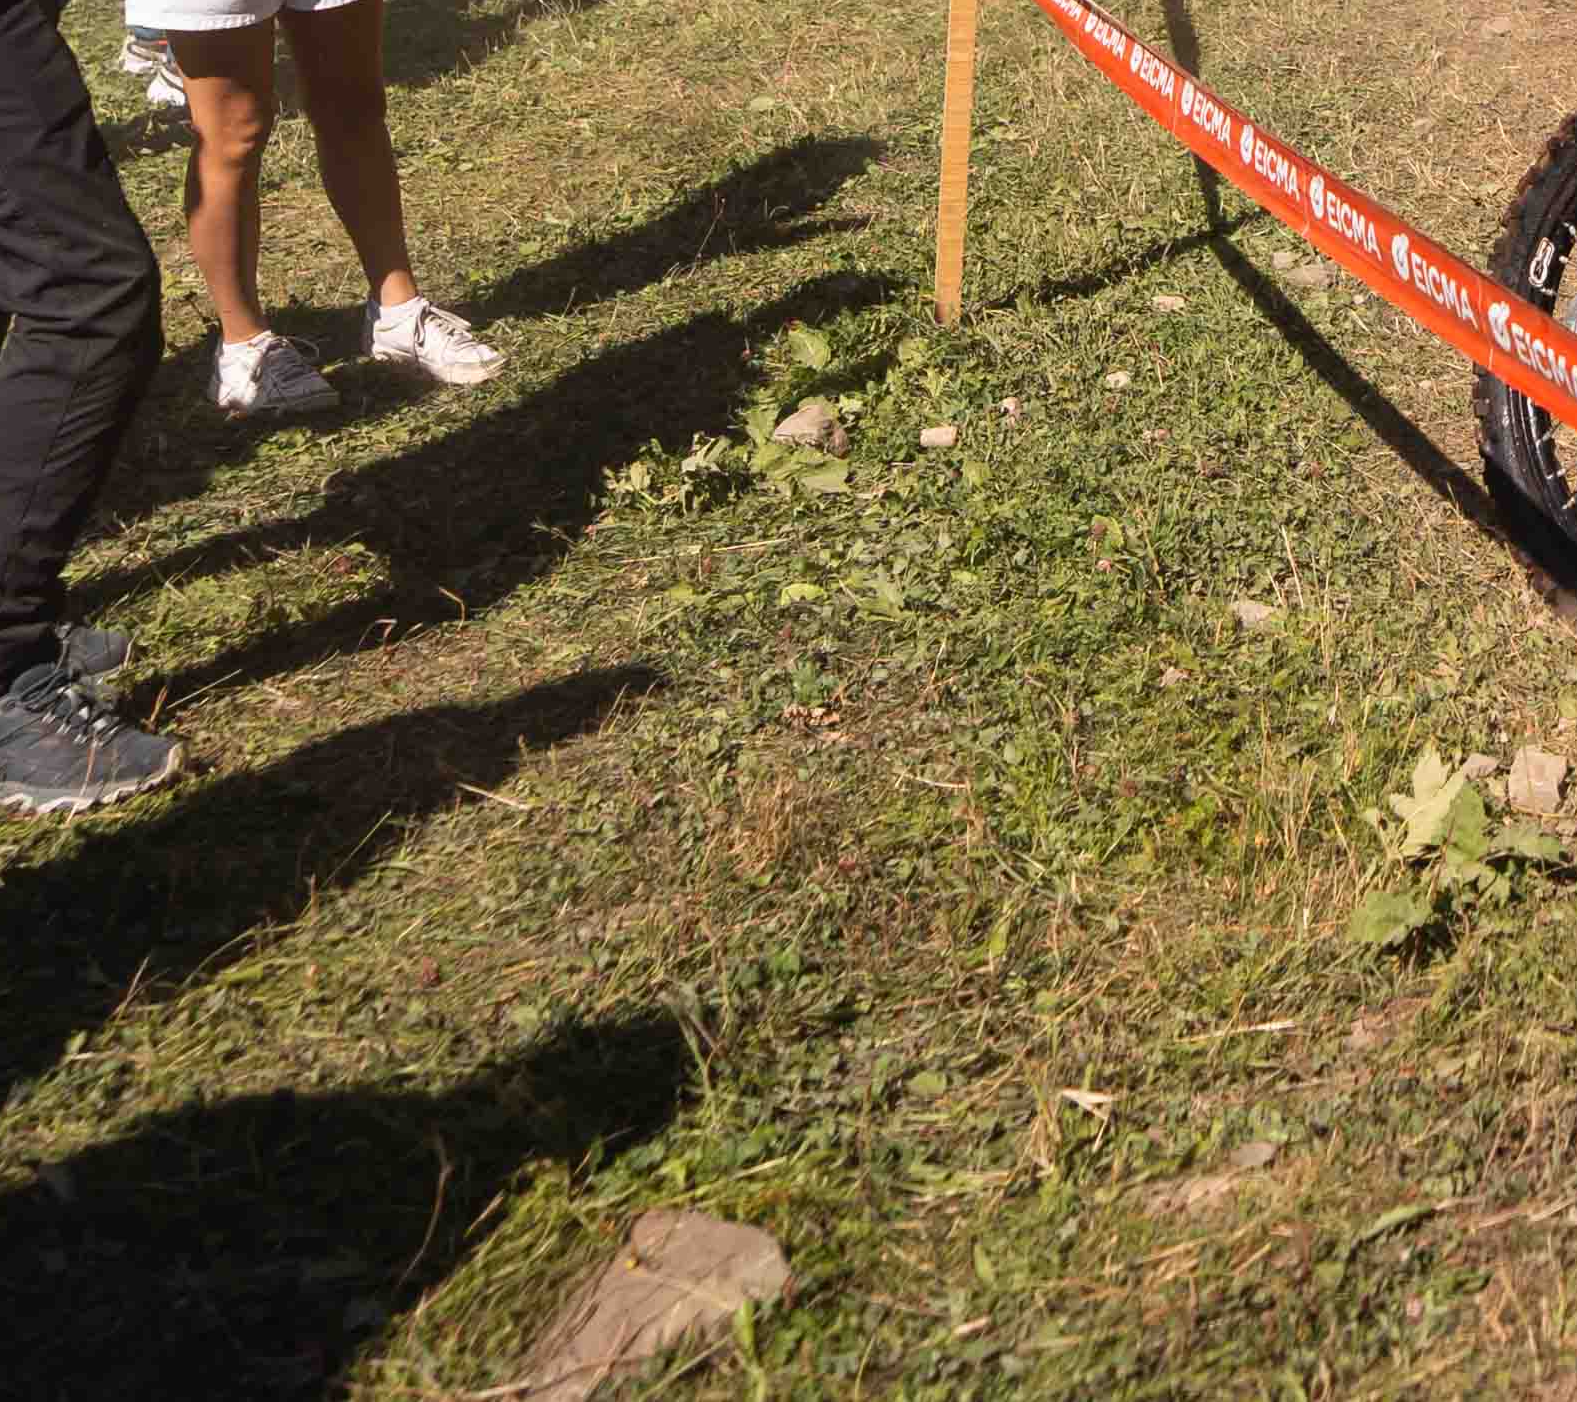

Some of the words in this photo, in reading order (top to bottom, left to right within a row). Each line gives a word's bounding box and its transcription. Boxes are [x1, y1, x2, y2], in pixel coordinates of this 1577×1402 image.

[1139, 51, 1176, 102] EICMA
[1192, 90, 1232, 152] EICMA
[1253, 139, 1302, 204] EICMA
[1325, 191, 1382, 263] EICMA
[1409, 252, 1480, 331] EICMA
